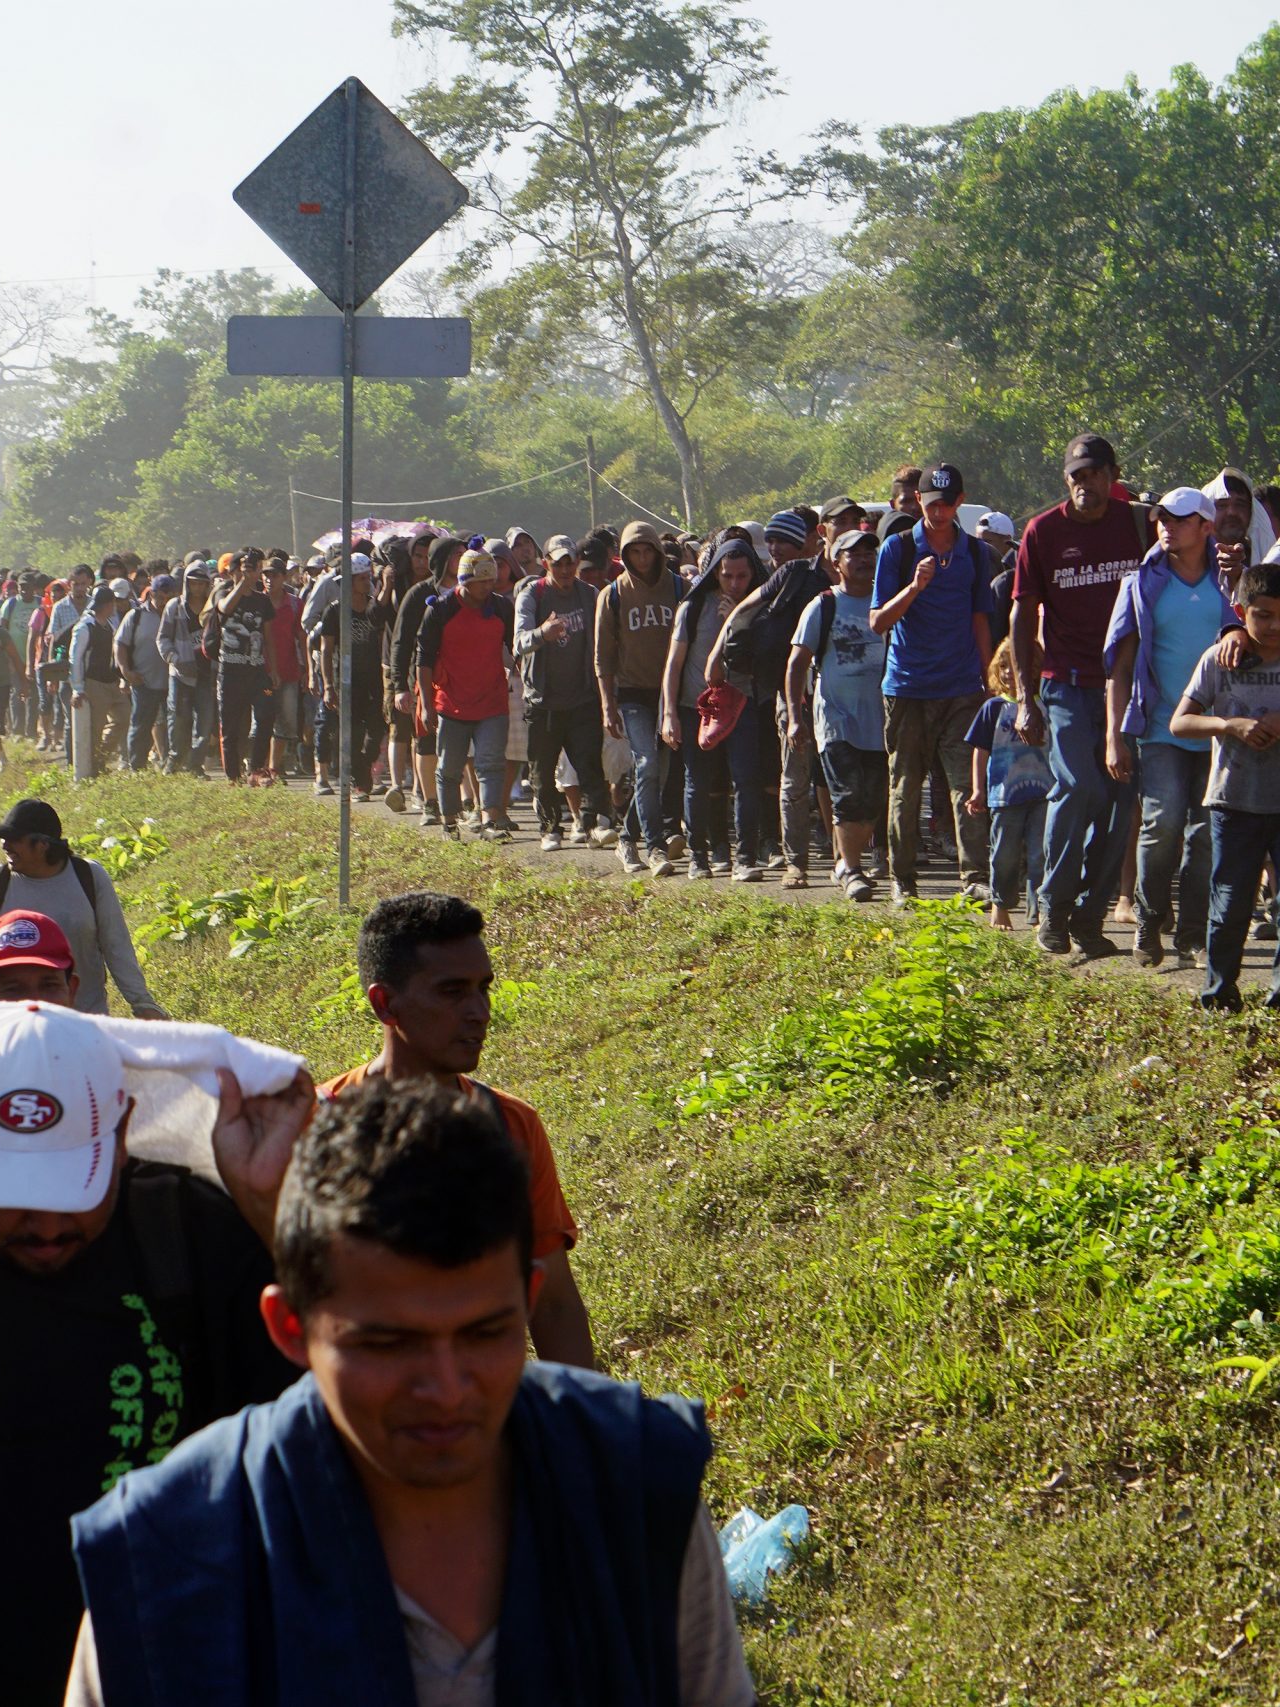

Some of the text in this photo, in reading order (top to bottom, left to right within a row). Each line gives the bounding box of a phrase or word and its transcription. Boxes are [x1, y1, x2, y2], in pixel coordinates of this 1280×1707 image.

[1052, 567, 1075, 583] POR
[1080, 564, 1094, 575] LA
[628, 604, 673, 631] GAP
[9, 1094, 51, 1128] SF
